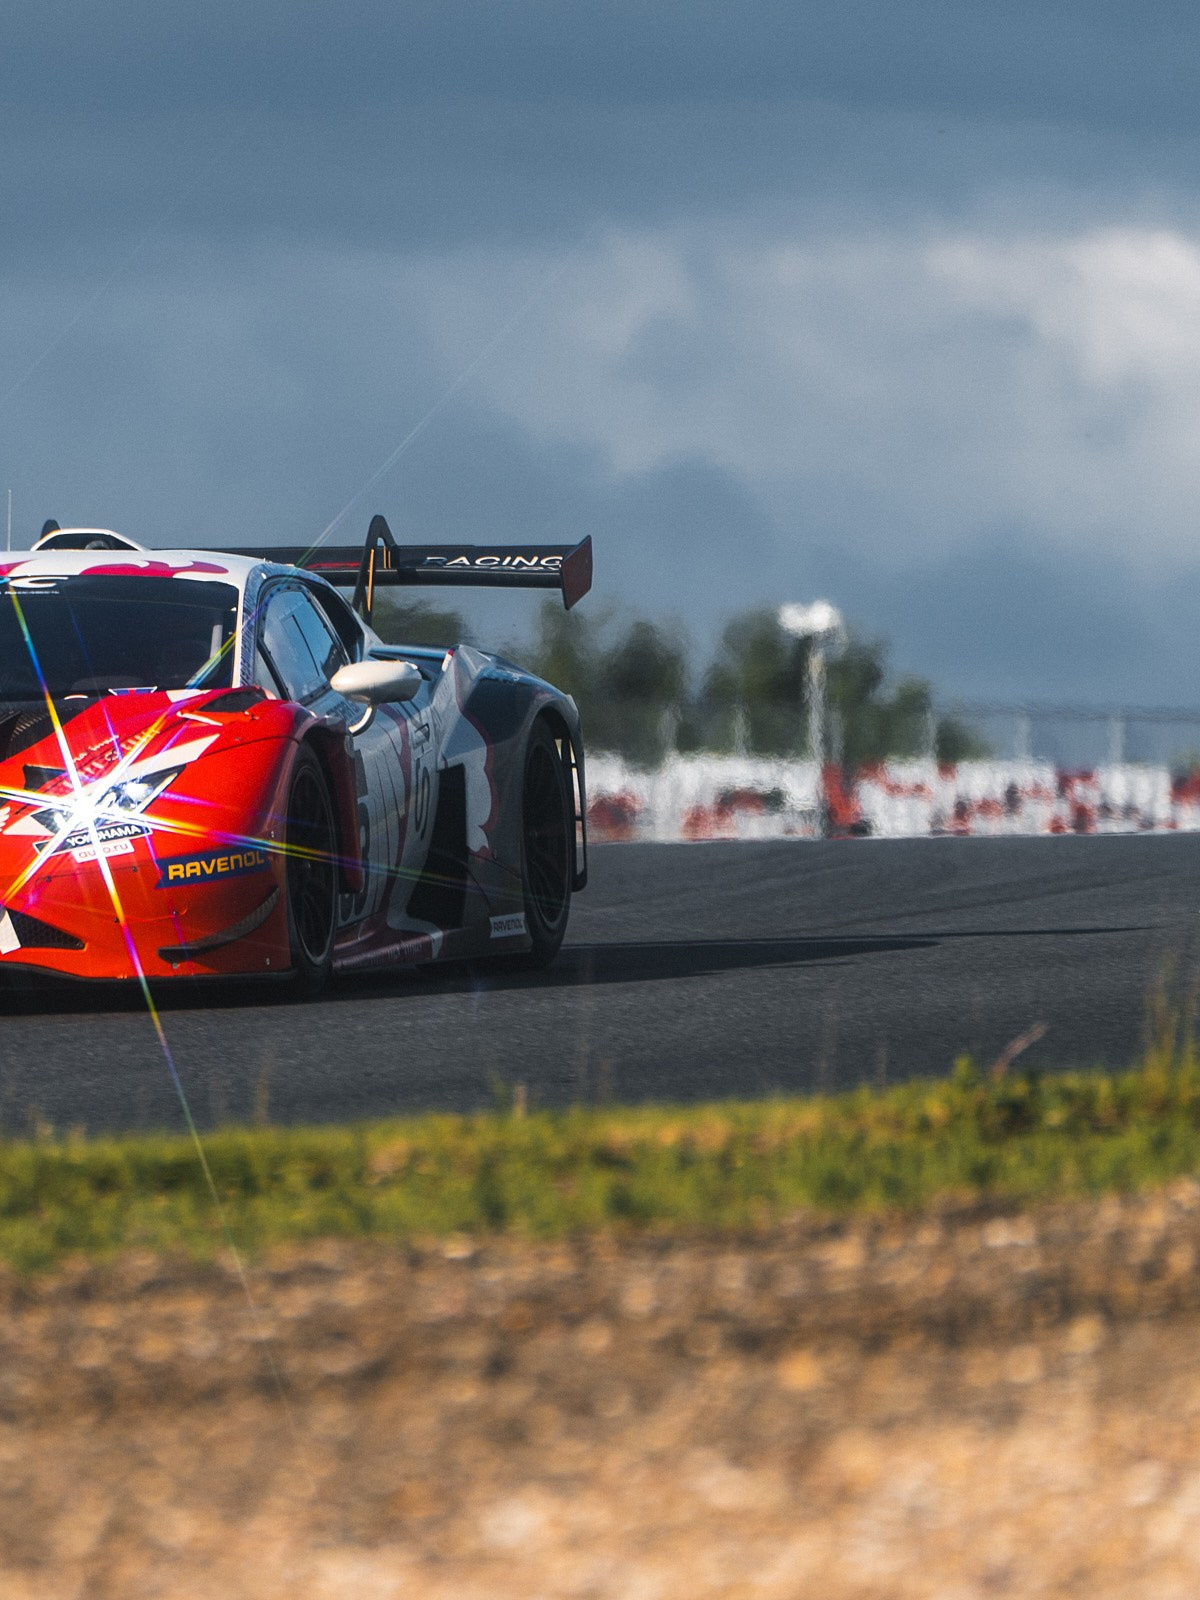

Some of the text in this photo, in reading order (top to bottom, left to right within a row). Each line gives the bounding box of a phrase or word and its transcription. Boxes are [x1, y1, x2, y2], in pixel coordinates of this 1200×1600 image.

[422, 555, 564, 567] RACING
[79, 843, 128, 859] auo.ru
[168, 851, 265, 880] RAVENOL
[493, 919, 524, 932] RAVENOL
